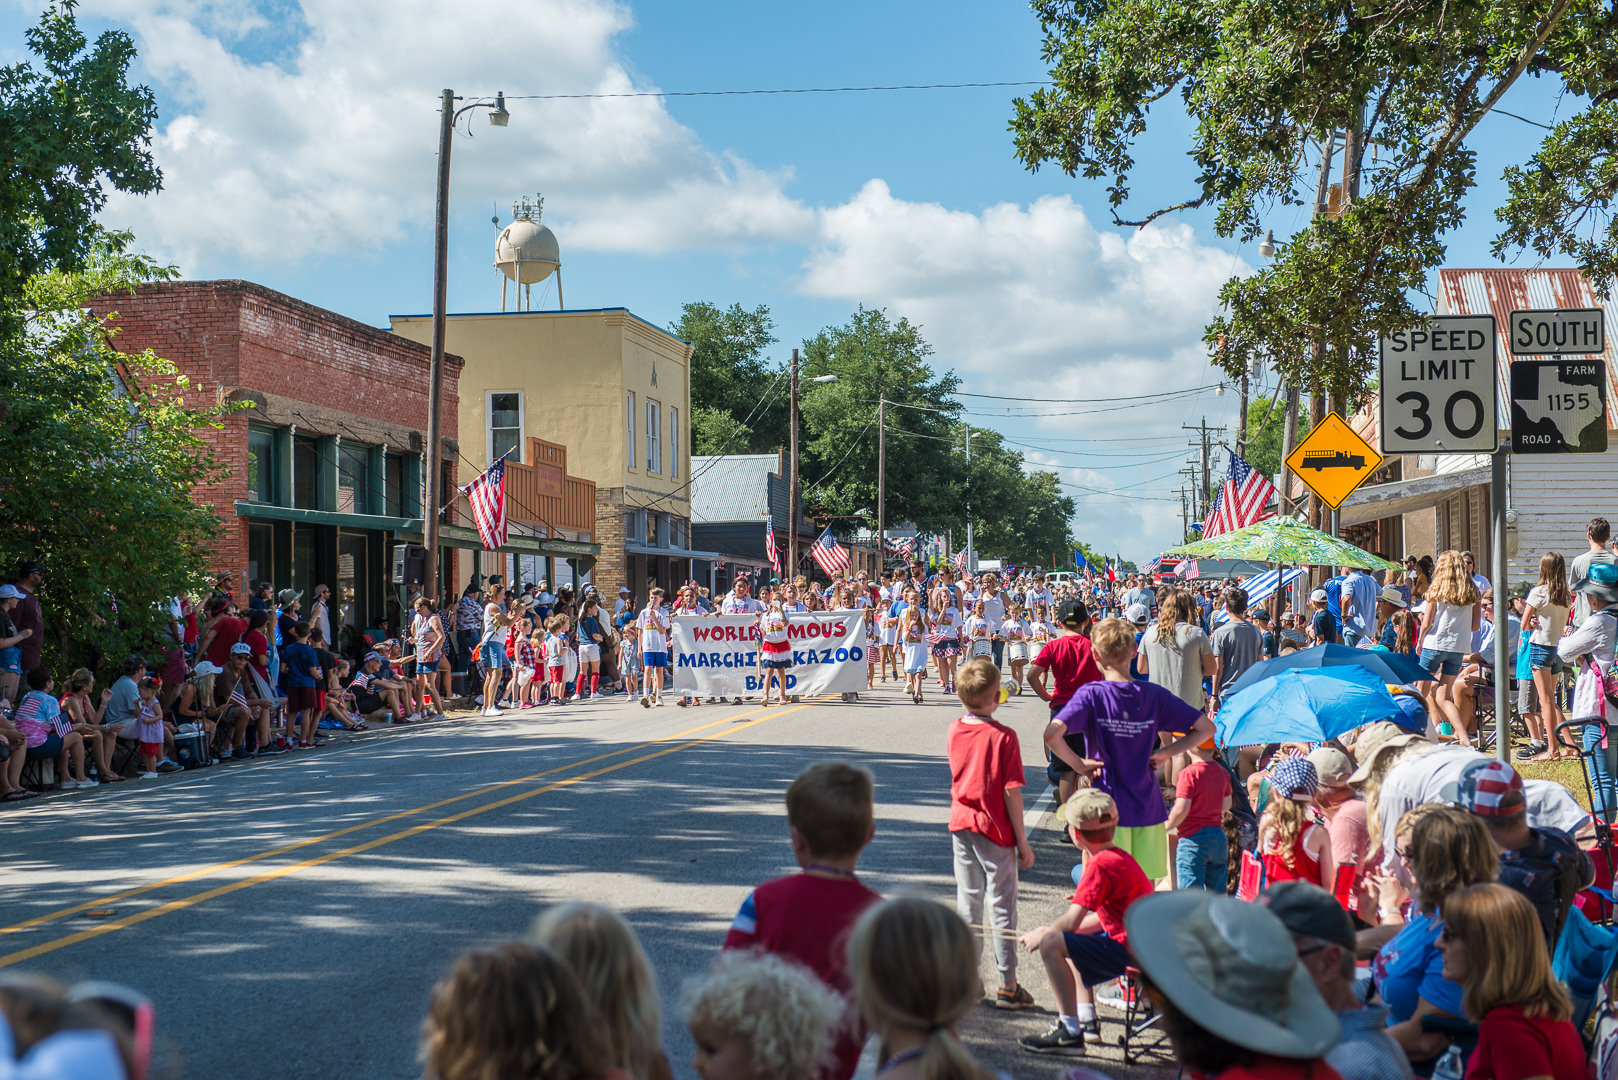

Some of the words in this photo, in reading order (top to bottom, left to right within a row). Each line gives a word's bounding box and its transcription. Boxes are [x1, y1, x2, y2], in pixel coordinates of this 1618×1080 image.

[1391, 330, 1486, 352] SPEED
[1517, 318, 1598, 347] SOUTH
[1401, 359, 1475, 380] LIMIT
[1566, 365, 1596, 375] FARM
[1548, 393, 1590, 411] 1155
[1393, 390, 1485, 440] 30
[1522, 435, 1551, 444] ROAD
[693, 625, 757, 642] WORLD
[787, 621, 847, 639] MOUS
[678, 651, 758, 668] MARCHI
[793, 646, 863, 665] KAZOO
